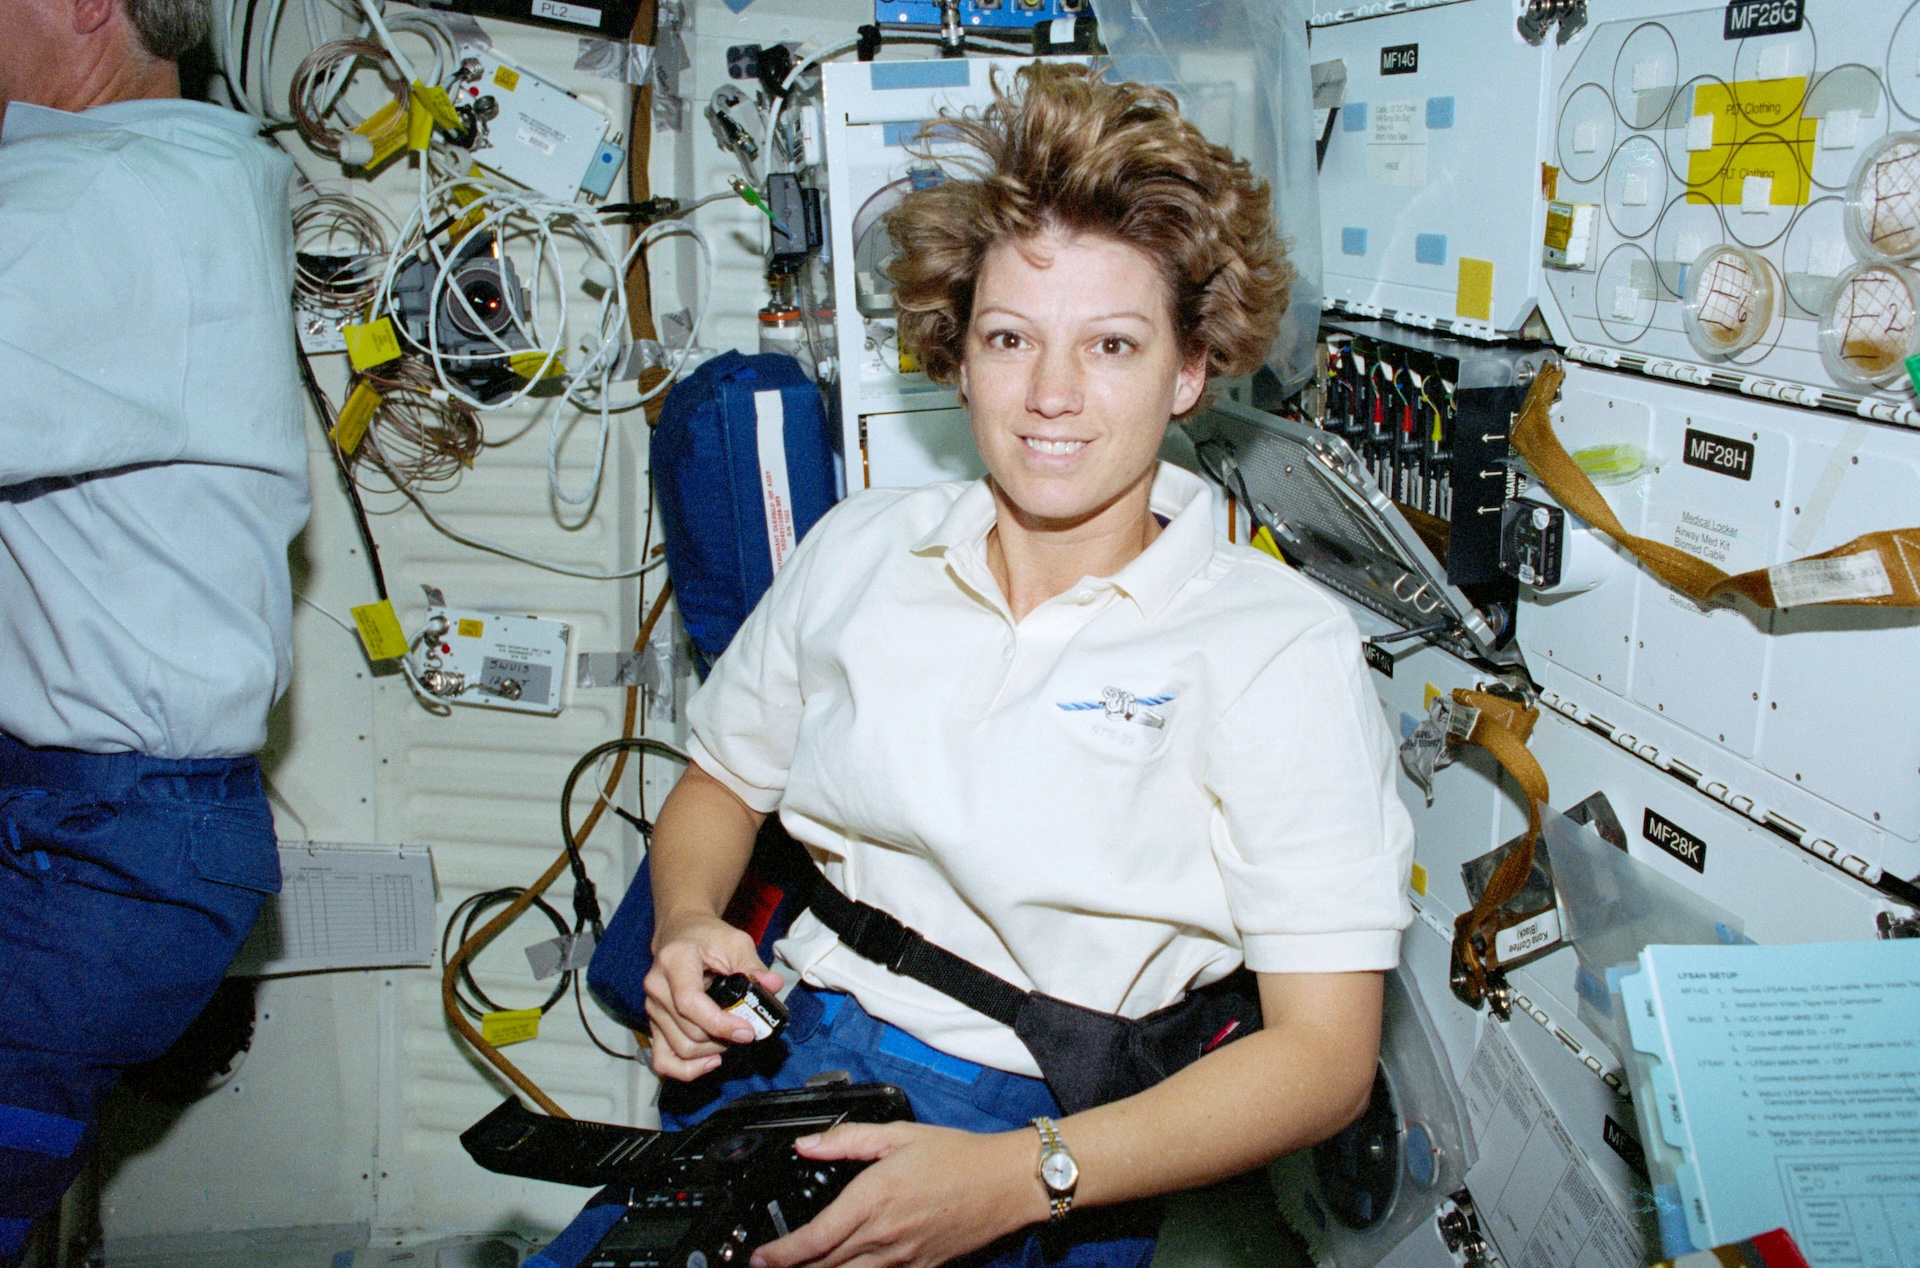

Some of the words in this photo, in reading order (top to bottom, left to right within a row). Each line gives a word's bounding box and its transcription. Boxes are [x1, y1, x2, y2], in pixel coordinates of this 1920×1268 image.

[541, 2, 568, 18] PL2
[1730, 1, 1798, 30] MF28G
[1383, 49, 1416, 69] MF14G
[1725, 103, 1741, 116] PLT
[1744, 102, 1781, 115] Clothing
[1884, 302, 1907, 334] 2
[1690, 437, 1747, 471] MF28H
[1682, 511, 1711, 527] Medical
[1712, 520, 1738, 537] Locker
[1673, 536, 1702, 554] Biomed
[1703, 545, 1726, 562] Cable
[1674, 525, 1700, 543] Airway
[1701, 532, 1718, 548] Med
[1719, 538, 1731, 551] Kit
[1362, 643, 1391, 673] MF14K
[1648, 816, 1700, 864] MF28K
[1516, 921, 1538, 939] (Black)
[1531, 930, 1548, 945] Kona
[1508, 938, 1531, 953] Coffee
